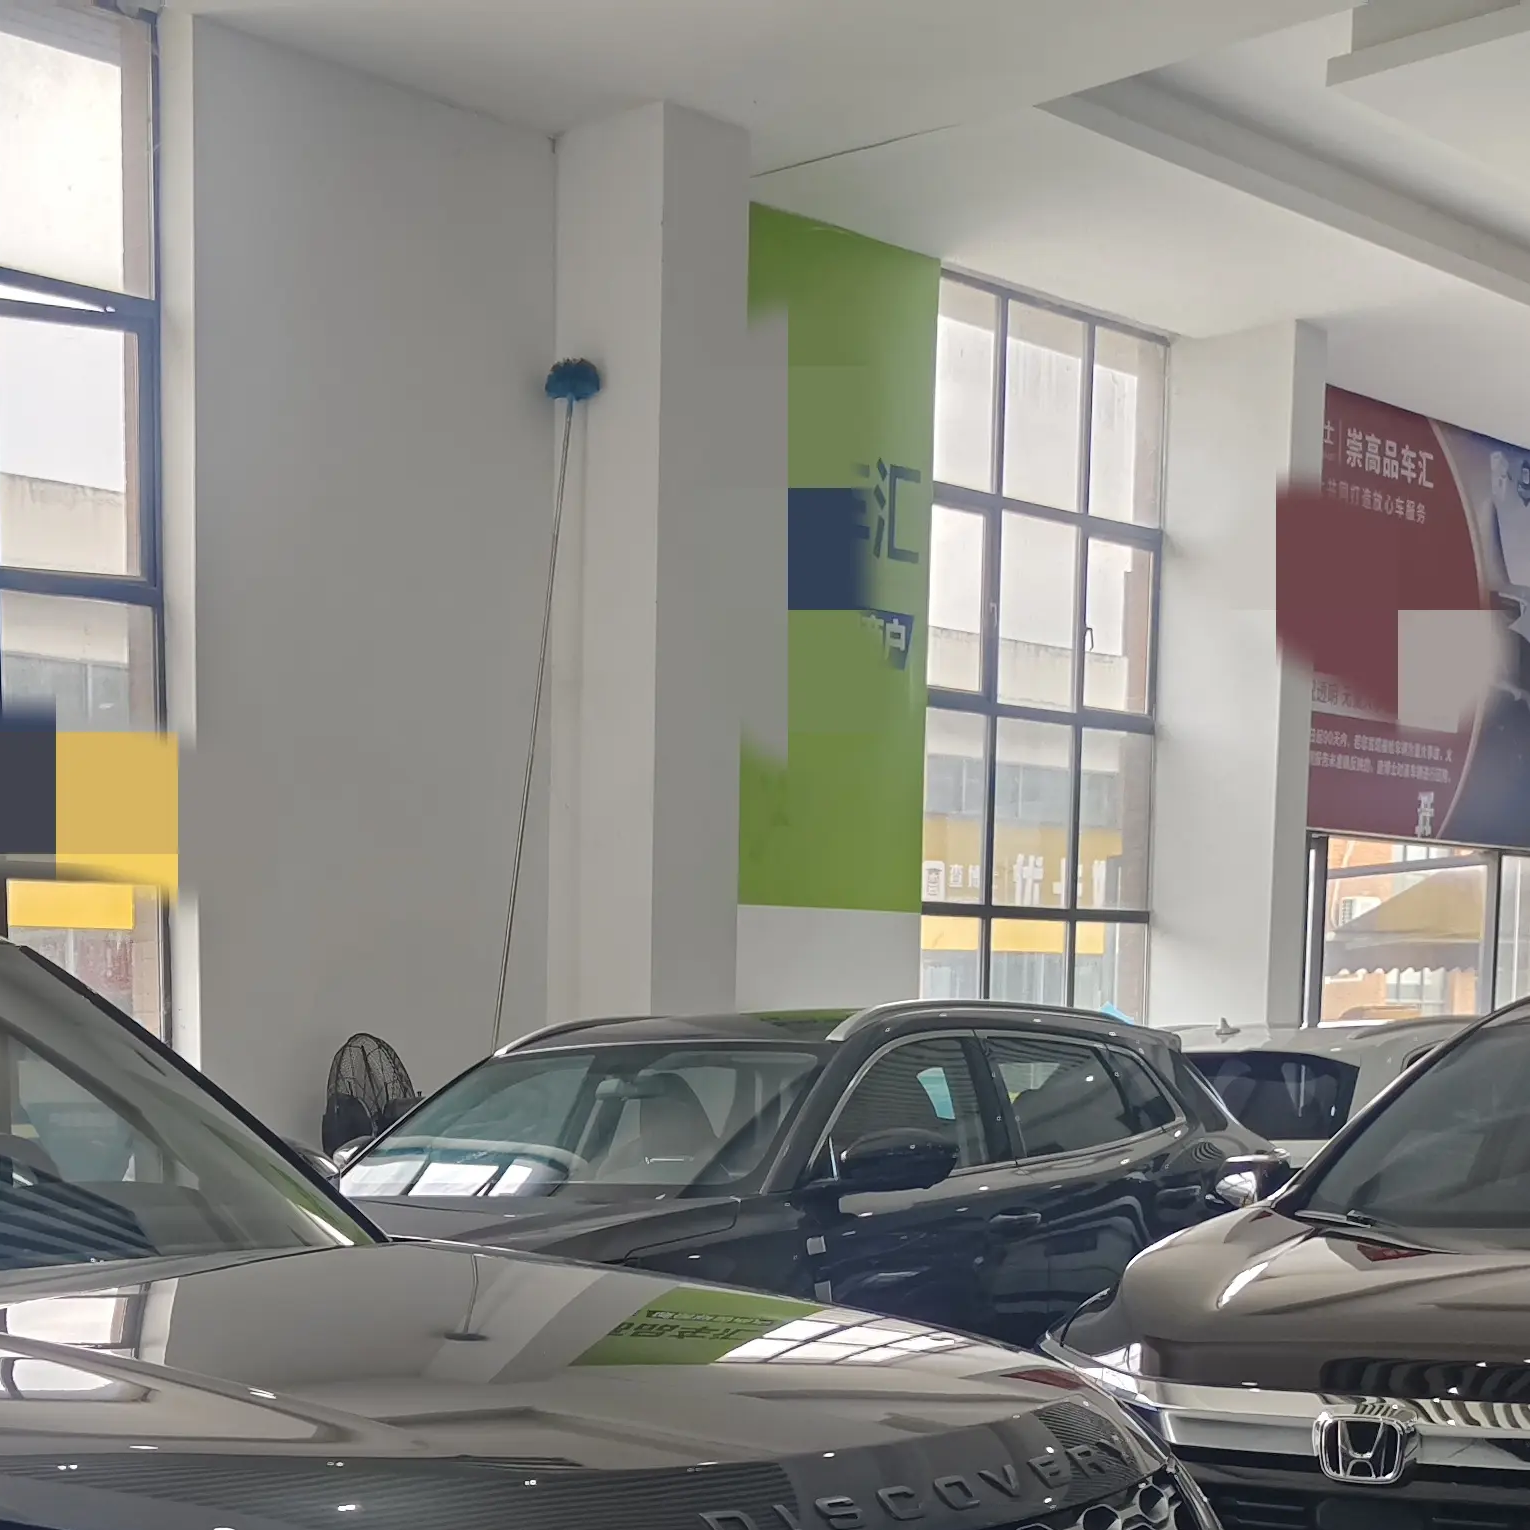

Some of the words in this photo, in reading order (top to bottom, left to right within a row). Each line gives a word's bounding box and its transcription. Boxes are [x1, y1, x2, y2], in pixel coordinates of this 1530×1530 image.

[1346, 427, 1435, 489] 崇高品车汇
[854, 457, 922, 565] 汇
